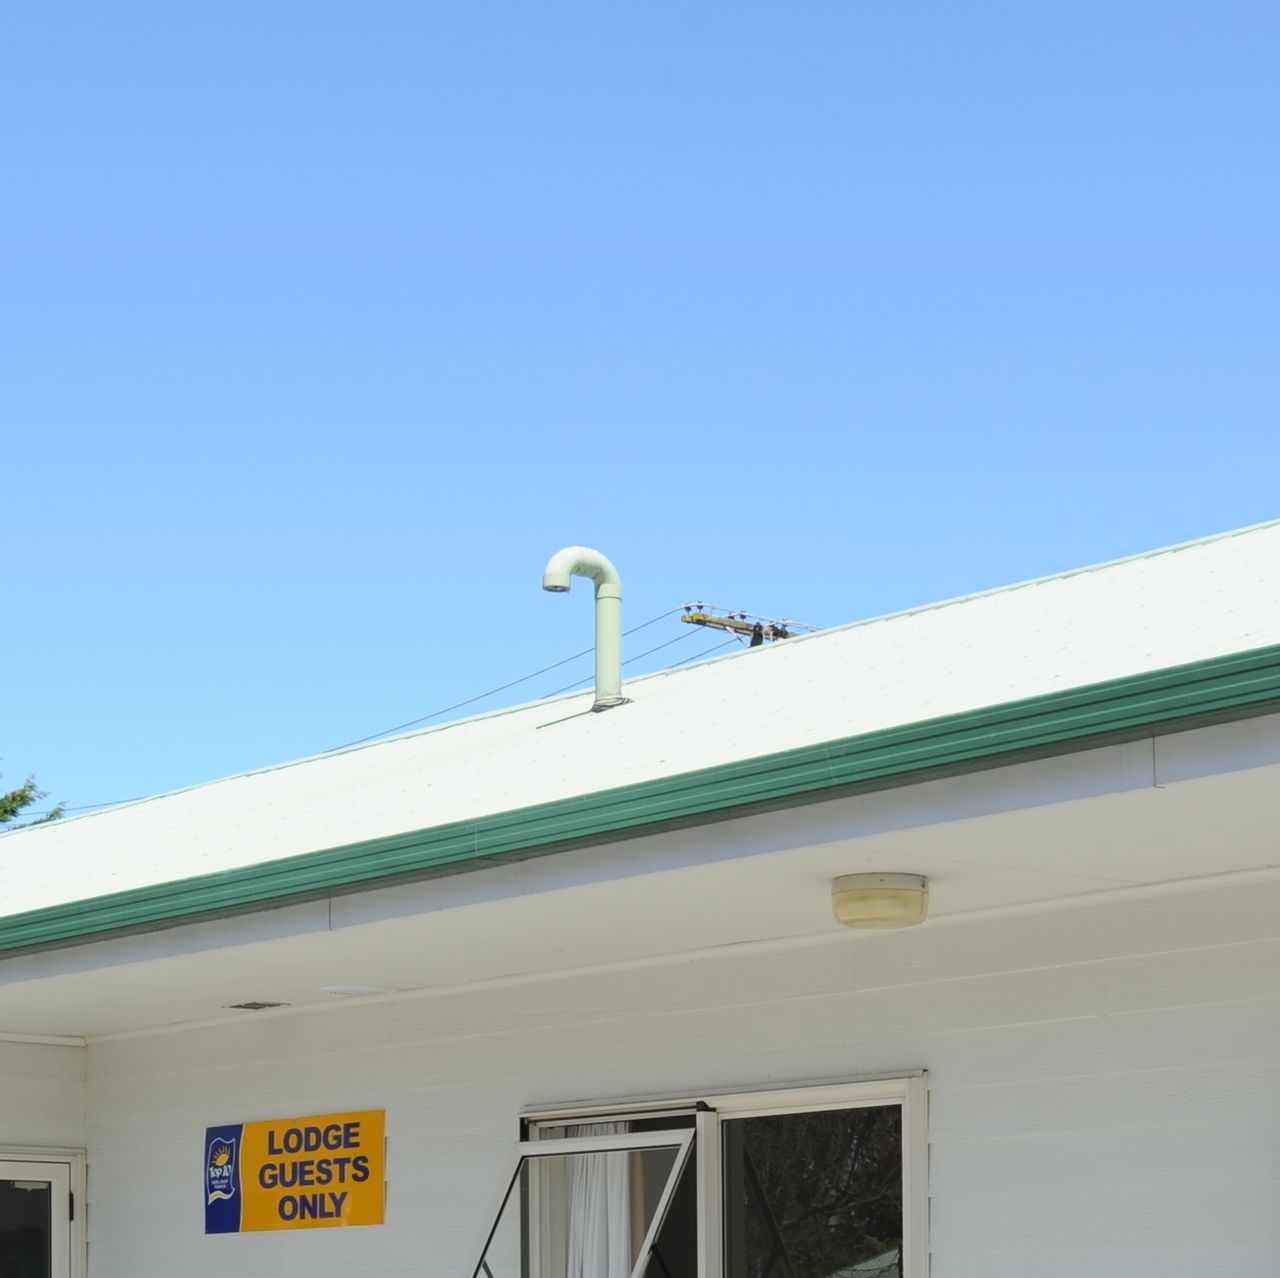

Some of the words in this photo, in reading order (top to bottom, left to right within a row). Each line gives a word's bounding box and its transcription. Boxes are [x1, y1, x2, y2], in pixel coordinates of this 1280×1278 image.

[267, 1122, 361, 1155] LODGE
[258, 1155, 370, 1189] GUESTS
[278, 1191, 348, 1221] ONLY
